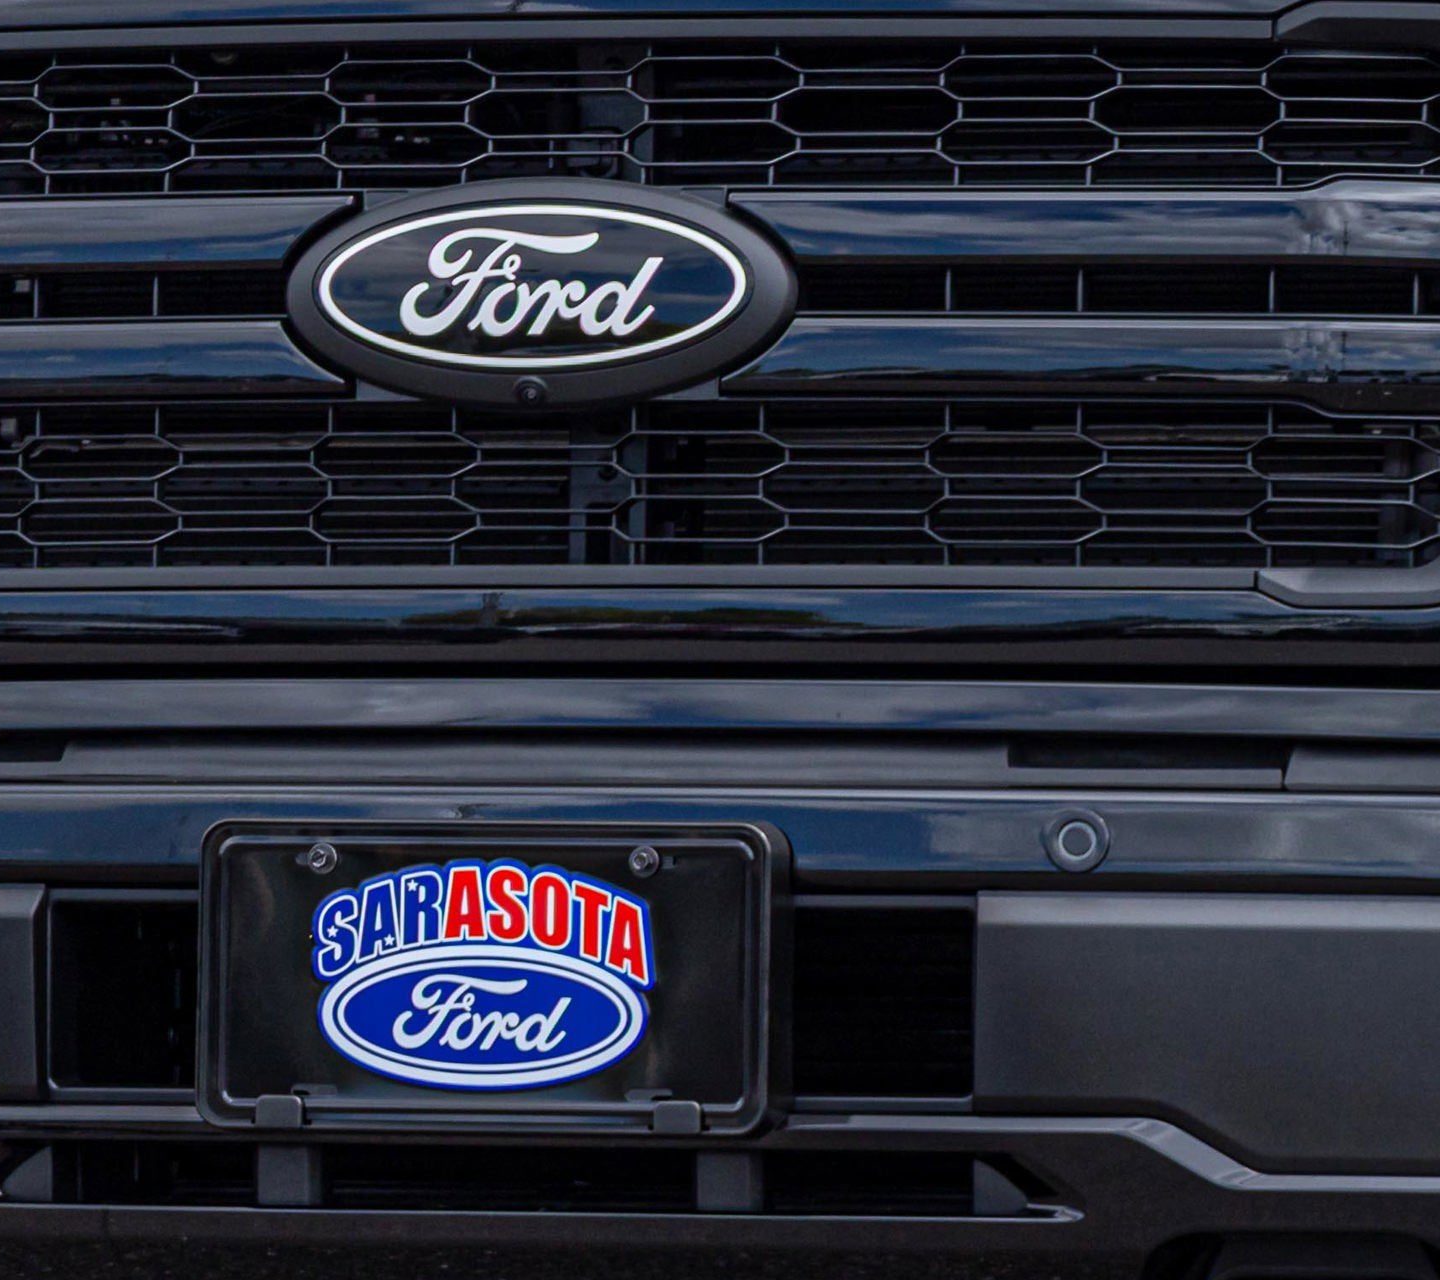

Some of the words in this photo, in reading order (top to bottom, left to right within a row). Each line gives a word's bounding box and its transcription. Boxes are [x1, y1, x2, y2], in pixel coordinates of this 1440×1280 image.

[399, 227, 664, 337] Ford
[316, 865, 650, 986] SARASOTA
[392, 973, 572, 1053] Ford
